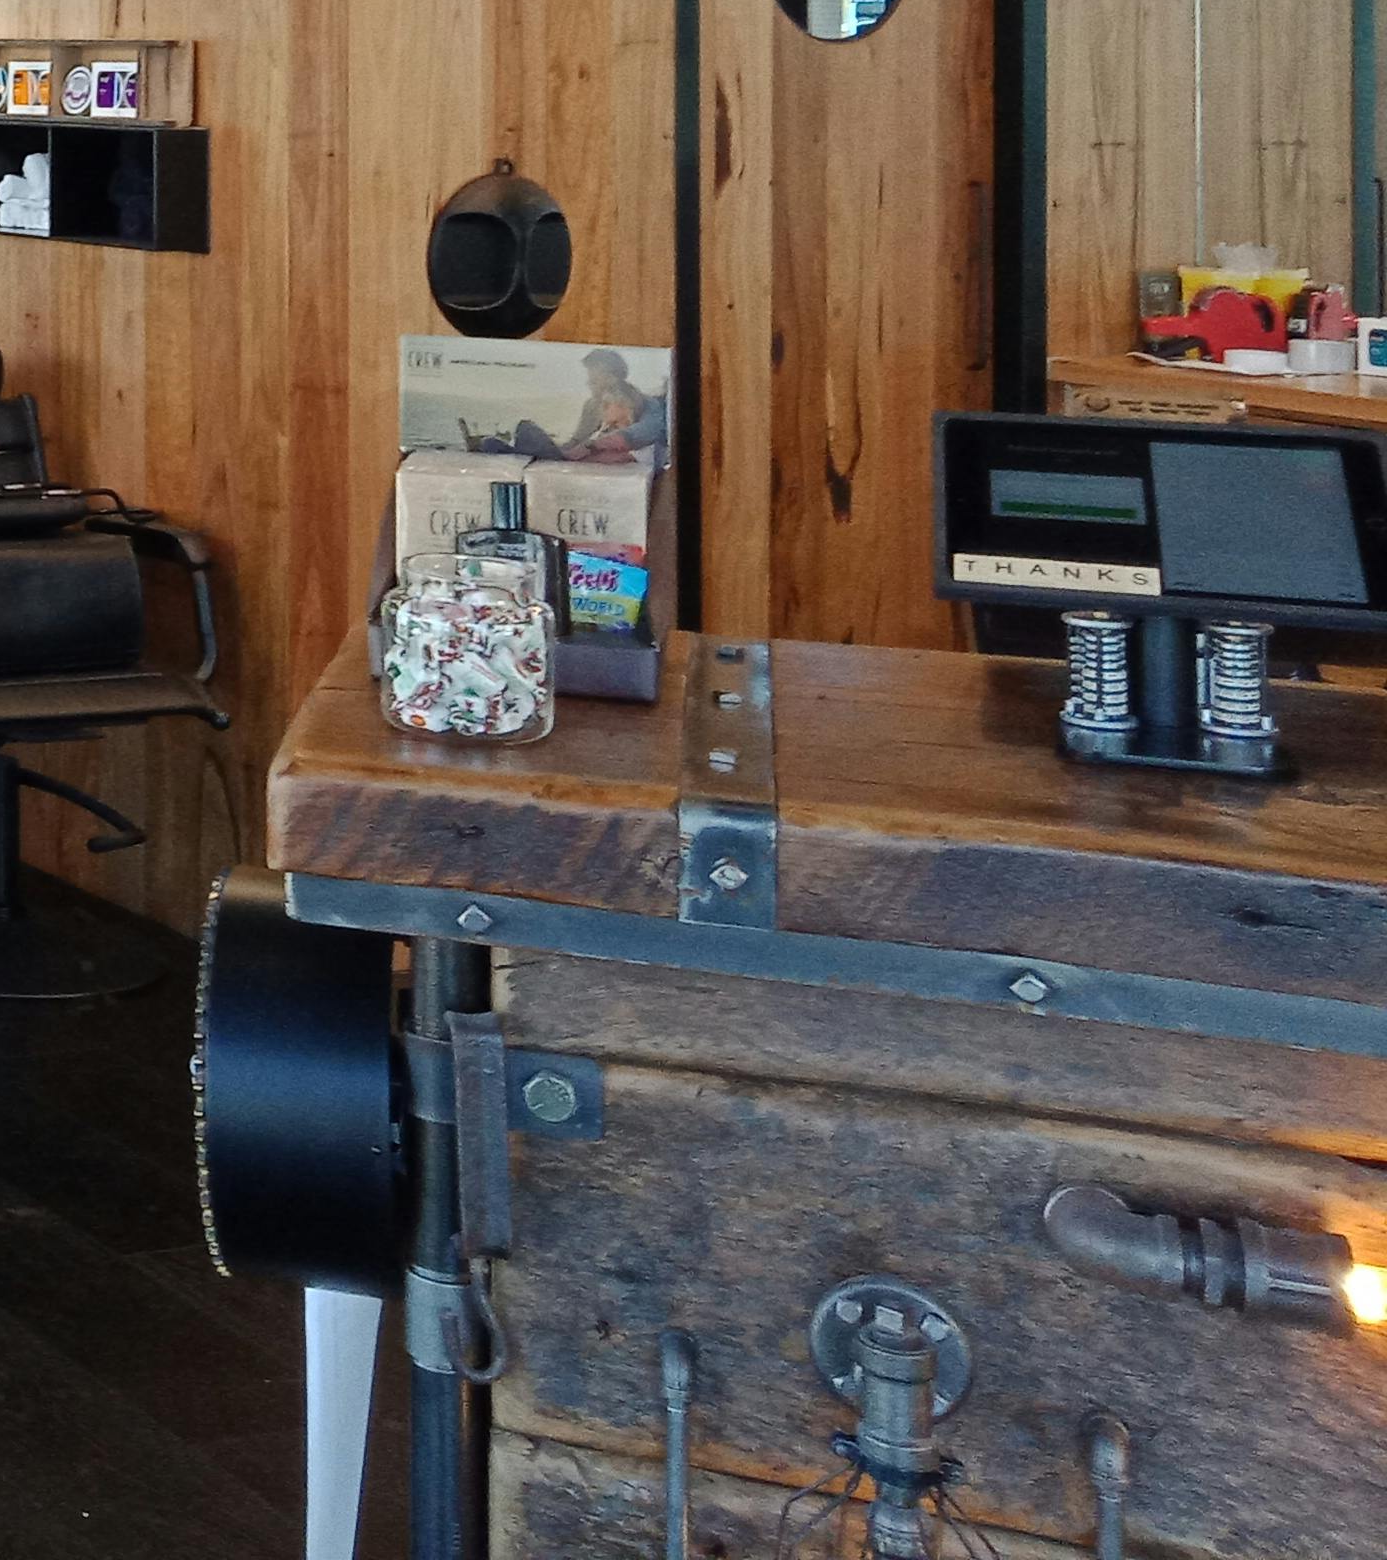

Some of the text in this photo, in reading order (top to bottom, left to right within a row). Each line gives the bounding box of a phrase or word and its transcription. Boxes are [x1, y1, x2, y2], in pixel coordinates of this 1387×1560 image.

[429, 510, 481, 537] CREW
[556, 508, 610, 537] CREW
[964, 559, 1150, 587] THANKS
